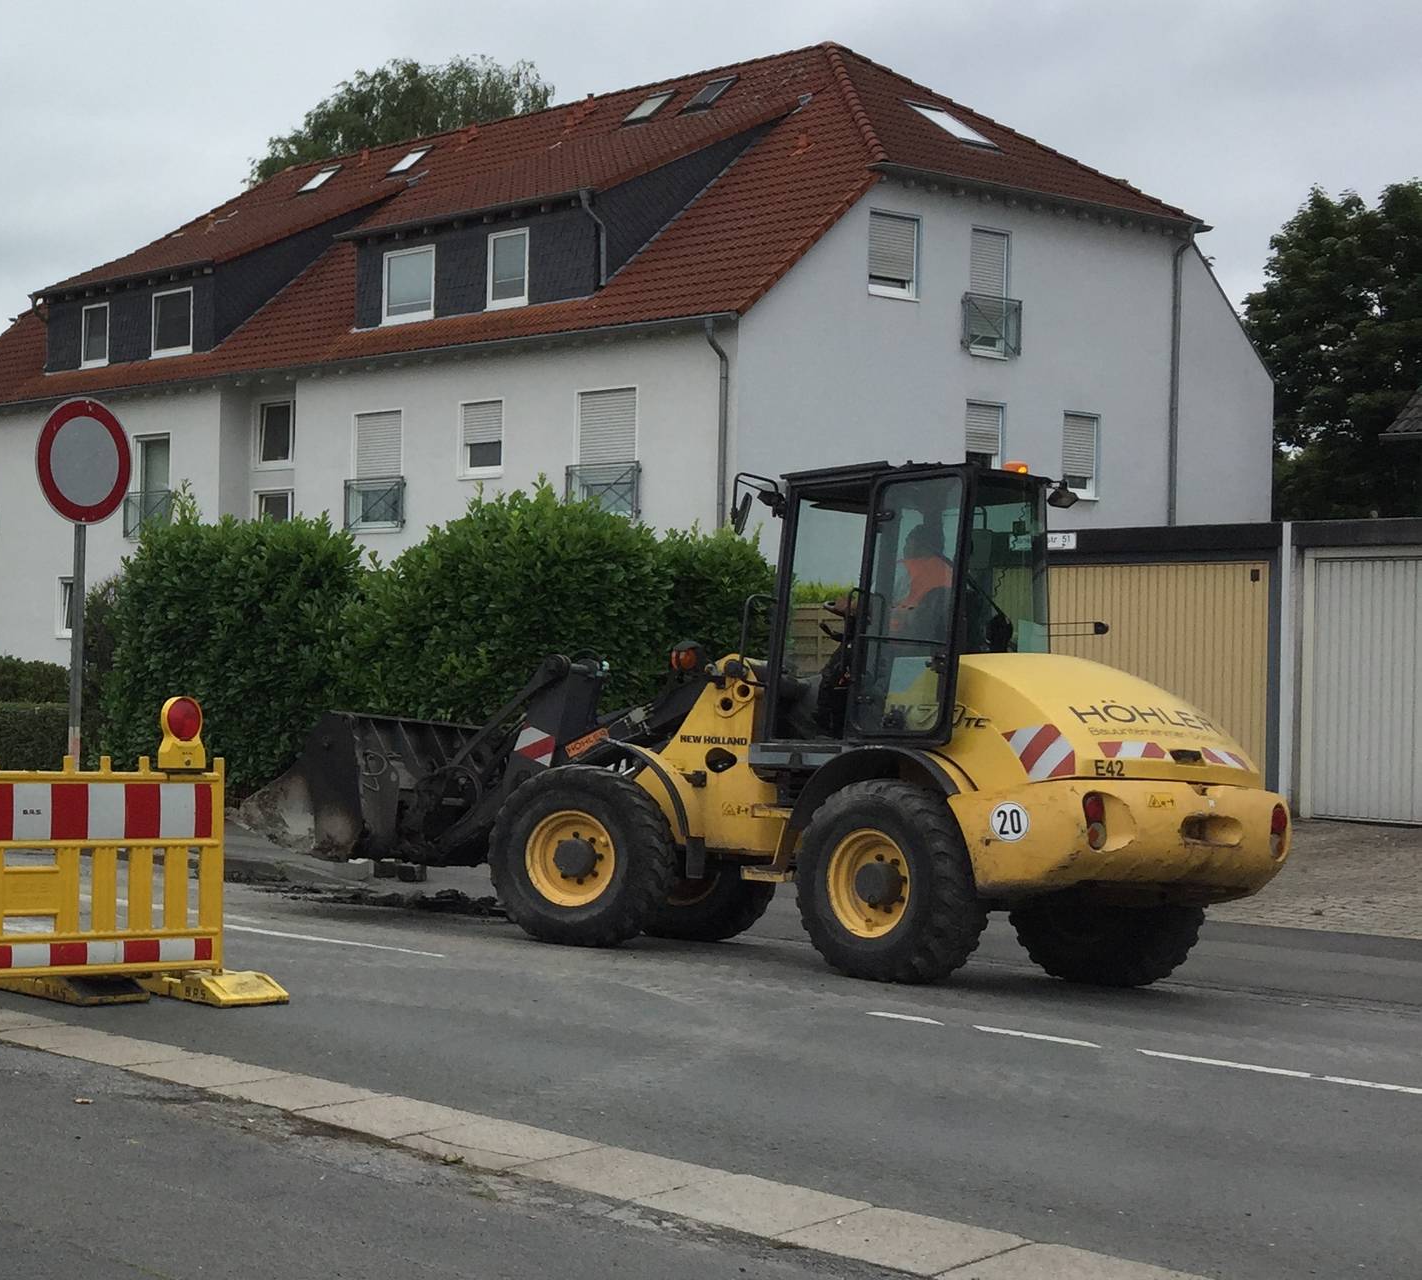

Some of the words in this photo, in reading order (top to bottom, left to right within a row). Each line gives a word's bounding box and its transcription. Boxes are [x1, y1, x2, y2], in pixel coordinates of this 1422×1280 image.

[1069, 700, 1222, 736] HÖHLER
[680, 735, 702, 744] NEW
[703, 736, 748, 746] HOLLAND
[1094, 760, 1125, 777] E42
[997, 808, 1022, 835] 20
